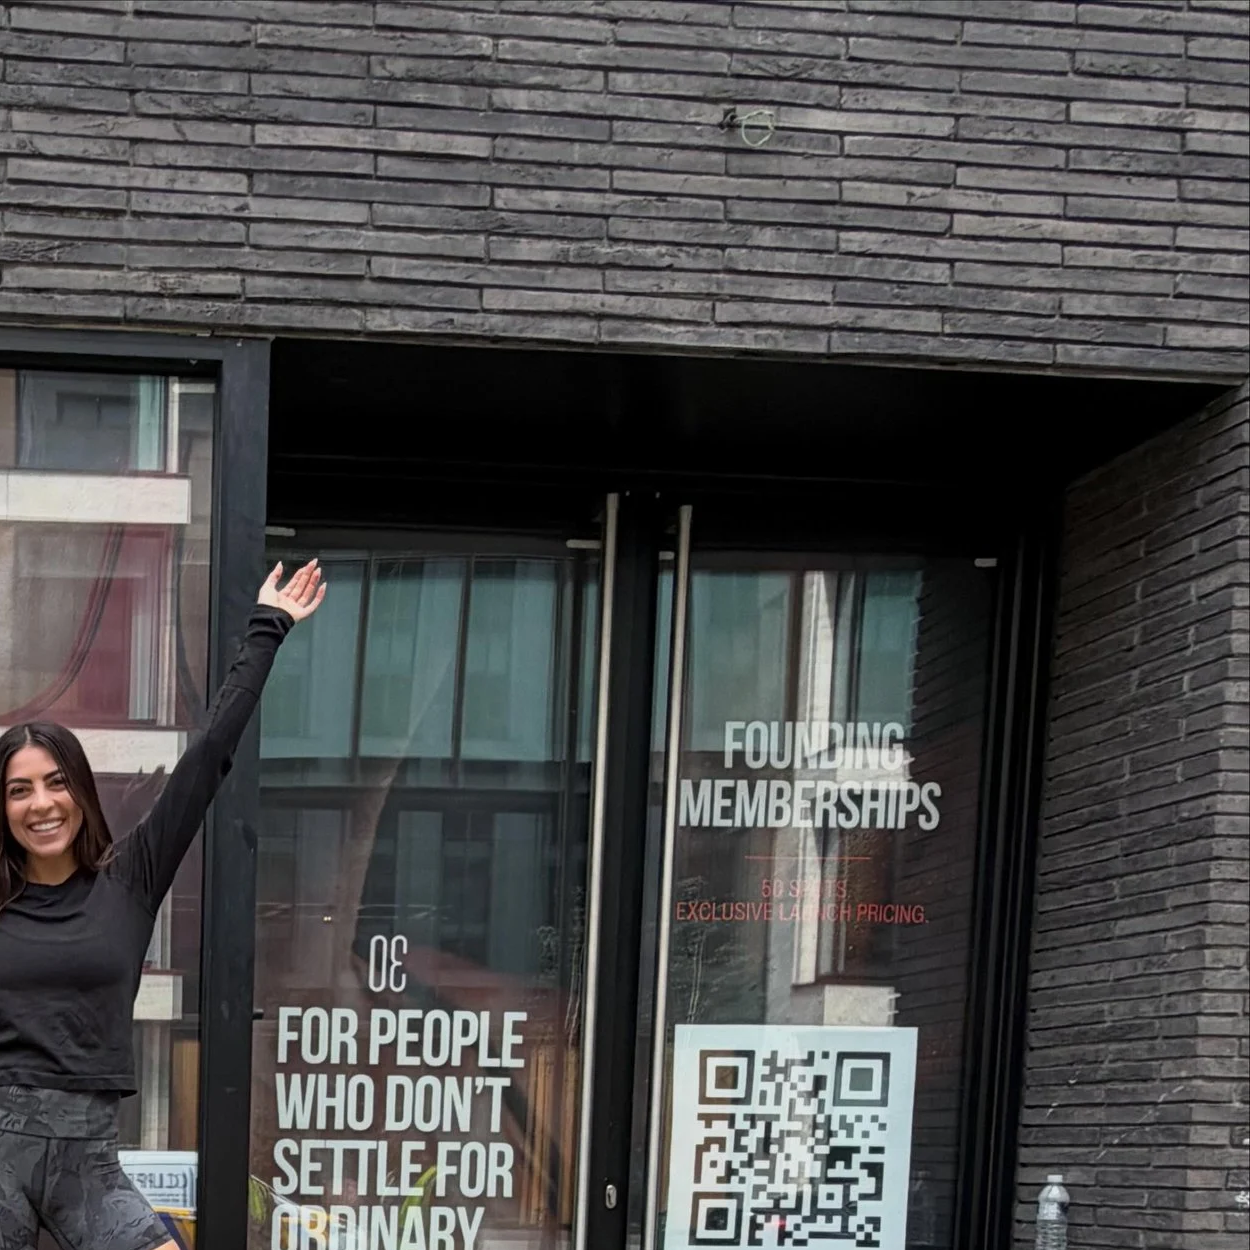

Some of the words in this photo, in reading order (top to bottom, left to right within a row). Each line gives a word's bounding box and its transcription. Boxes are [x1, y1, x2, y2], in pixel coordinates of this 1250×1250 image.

[723, 721, 905, 771] FOUNDING
[678, 779, 942, 831] MEMBERSHIPS
[675, 902, 772, 921] EXCLUSIVE
[779, 902, 851, 922] LANCH
[855, 903, 930, 924] PRICING.
[277, 1006, 358, 1065] FOR
[369, 1008, 528, 1068] PEOPLE
[275, 1073, 375, 1131] WHO
[385, 1075, 511, 1133] DON'T
[273, 1138, 427, 1197] SETTLE
[436, 1141, 514, 1198] FOR
